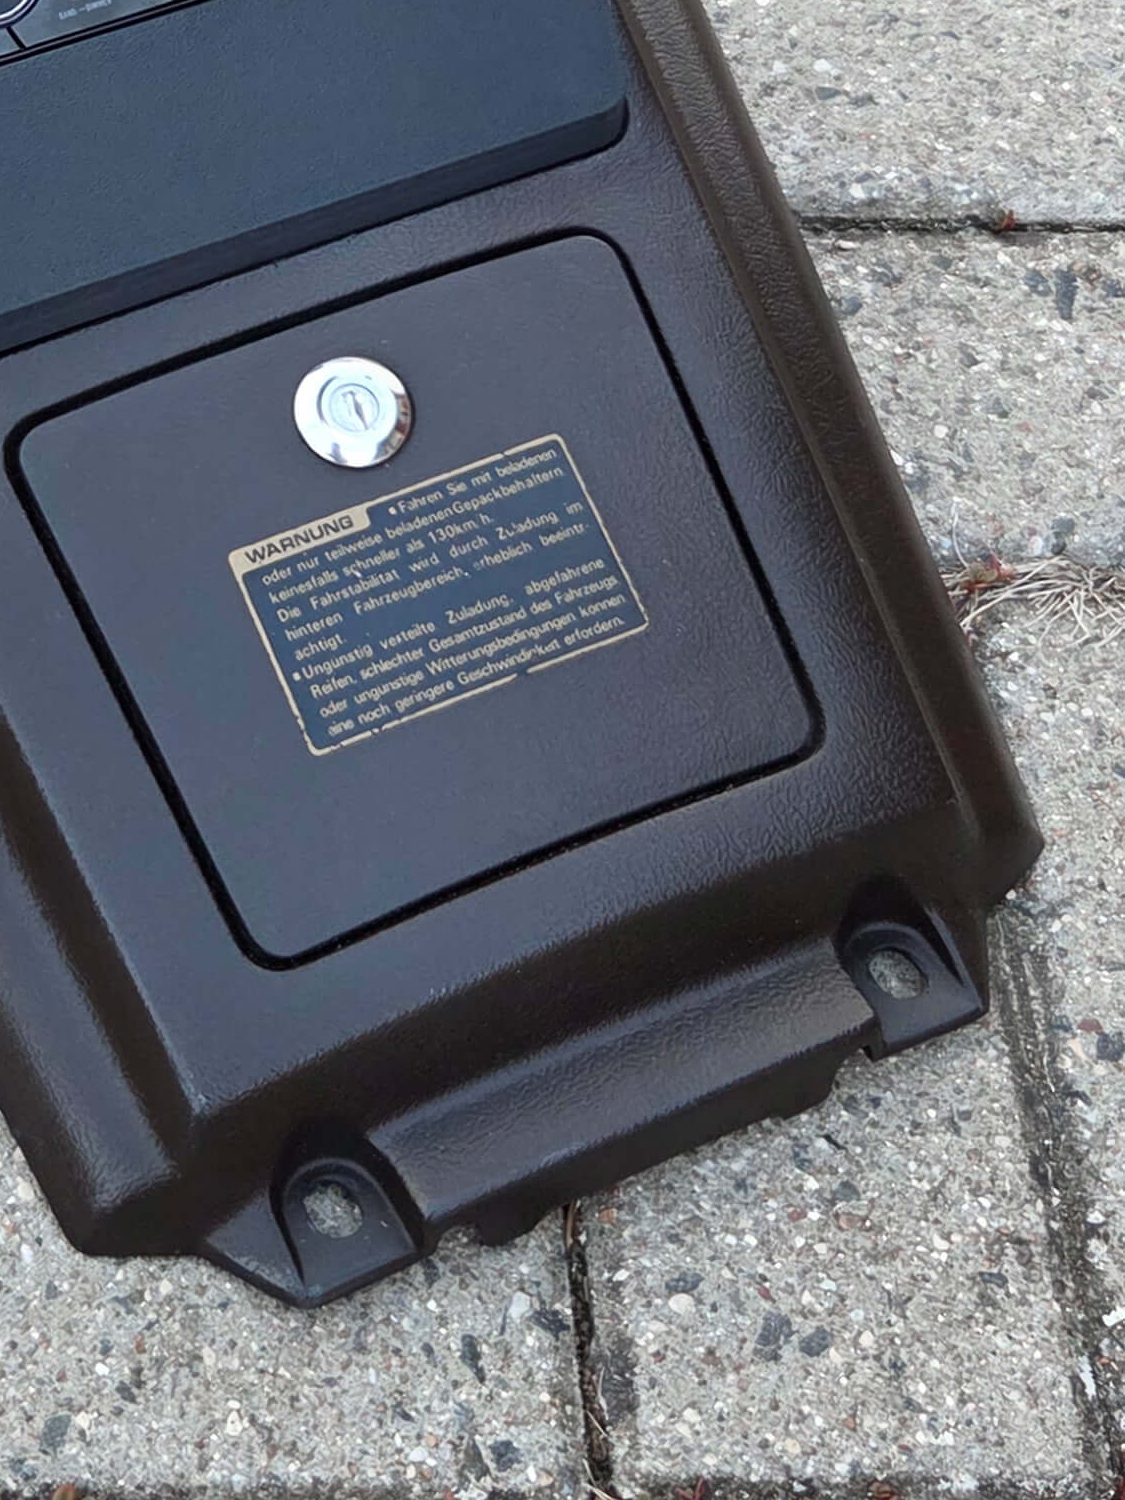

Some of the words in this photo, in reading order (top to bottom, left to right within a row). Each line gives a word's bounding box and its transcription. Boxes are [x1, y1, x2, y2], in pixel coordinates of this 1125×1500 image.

[398, 491, 444, 513] Fahren
[446, 481, 468, 495] Sie
[471, 471, 492, 486] mit
[495, 449, 557, 477] beladenen
[245, 515, 354, 564] WARNUNG
[262, 566, 292, 585] oder
[297, 556, 320, 571] nur
[325, 533, 383, 561] teilweise
[385, 507, 454, 539] beladenen
[269, 570, 340, 603] keinesfalls
[343, 547, 401, 576] schneller
[407, 538, 425, 553] als
[277, 606, 302, 622] Die
[409, 552, 440, 572] wird
[450, 535, 489, 558] durch
[564, 502, 584, 514] im
[285, 612, 344, 641] hinteren
[474, 541, 533, 567] erheblich
[360, 647, 425, 679] schlechter
[429, 606, 528, 652] Gesamtzustand
[530, 599, 553, 614] des
[555, 575, 619, 604] Fahrzeugs
[380, 621, 436, 649] verteilte
[525, 558, 605, 595] abgefahrene
[320, 699, 348, 717] oder
[425, 612, 577, 675] Witterungsbedingungen
[329, 719, 355, 736] eine
[358, 703, 391, 724] noch
[395, 680, 455, 712] geringere
